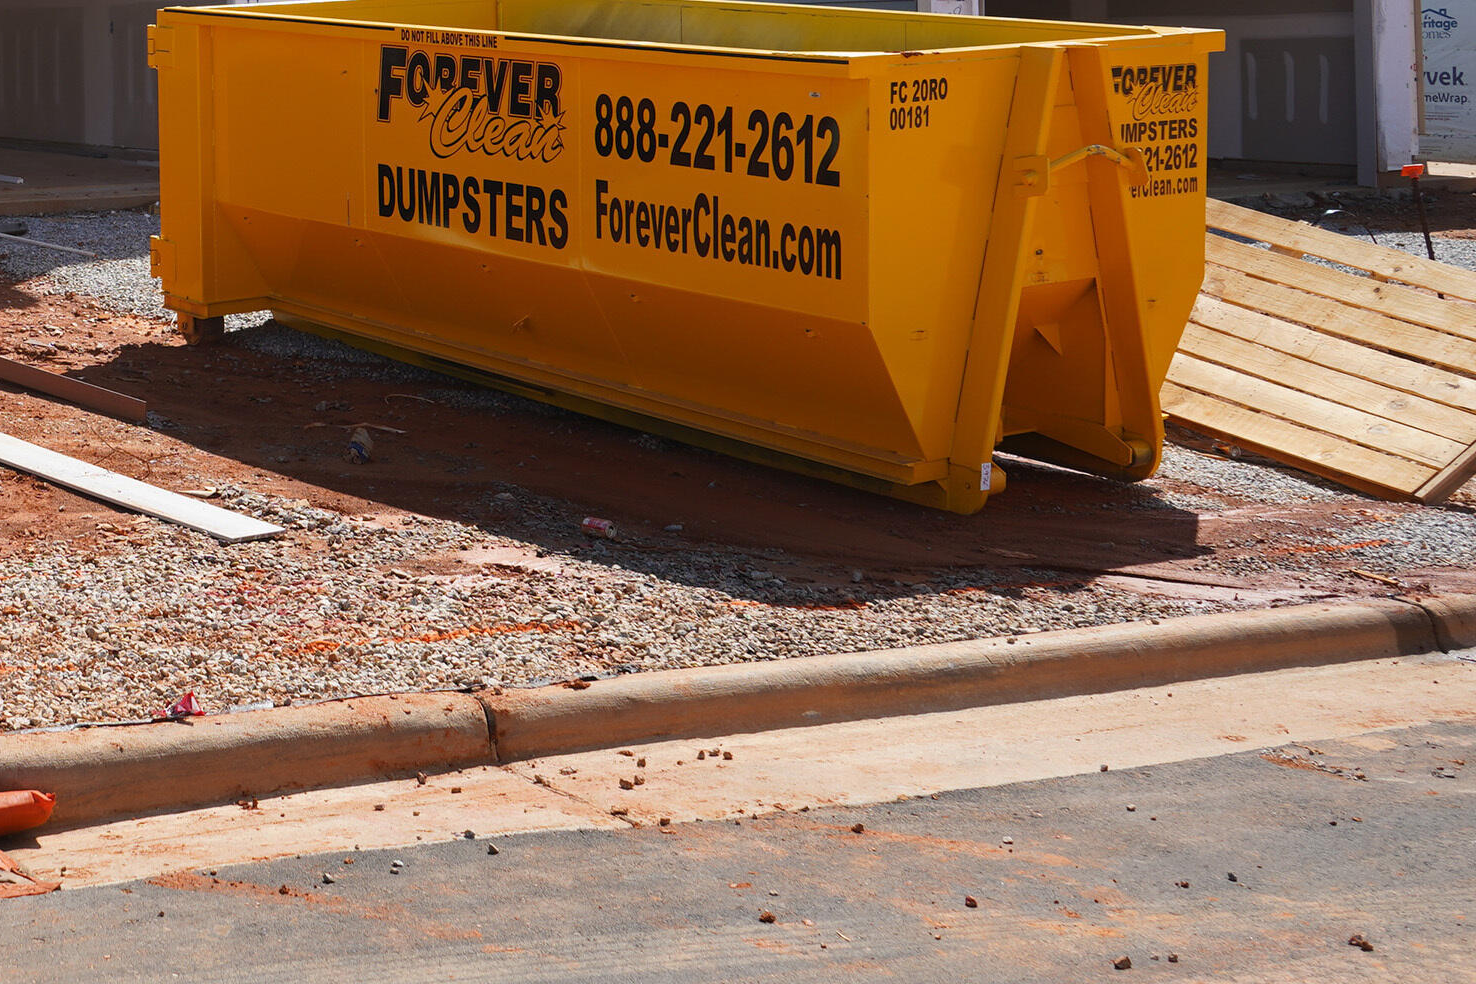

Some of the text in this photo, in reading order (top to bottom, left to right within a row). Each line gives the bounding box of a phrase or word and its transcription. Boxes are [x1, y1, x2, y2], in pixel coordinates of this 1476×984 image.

[1422, 30, 1451, 39] omes
[1423, 16, 1458, 30] ritage
[401, 29, 497, 48] DO NOT FILL ABOVE THIS LINE
[377, 44, 563, 123] FOREVER
[1424, 66, 1465, 86] vek
[890, 81, 908, 104] FC
[1425, 92, 1468, 104] meWrap
[429, 86, 564, 163] Clean
[890, 105, 929, 130] 00181
[594, 93, 841, 187] 888-221-2612
[1121, 118, 1198, 143] MPSTERS
[1145, 143, 1197, 172] 21-2612
[378, 163, 569, 250] DUMPSTERS
[595, 179, 842, 280] ForeverClean.com
